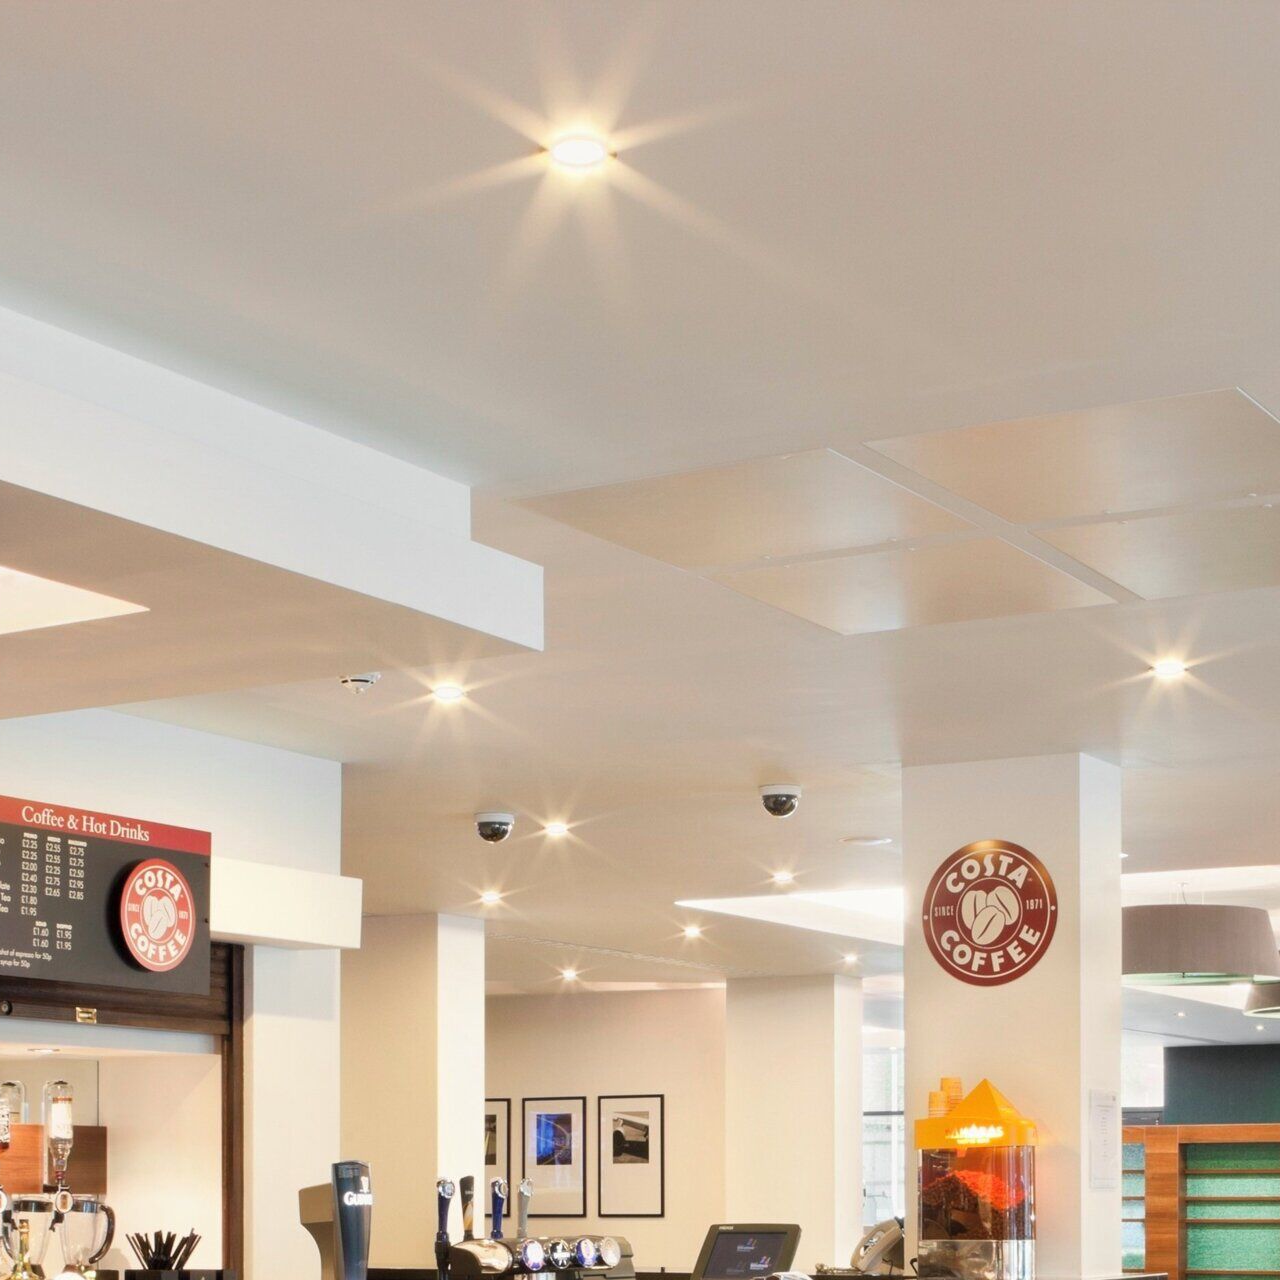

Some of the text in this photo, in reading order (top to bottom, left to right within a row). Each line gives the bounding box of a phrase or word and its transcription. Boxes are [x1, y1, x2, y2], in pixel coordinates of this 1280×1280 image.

[22, 806, 150, 842] Coffee & Hot Drinks
[22, 839, 37, 849] £2.25
[46, 843, 61, 853] £2.55
[70, 846, 84, 856] £2.75
[22, 850, 37, 860] £2.25
[46, 854, 60, 864] £2.55
[70, 858, 84, 867] £2.75
[22, 862, 37, 871] £2.00
[46, 865, 60, 875] £2.25
[69, 869, 84, 878] £2.50
[946, 854, 1029, 894] COSTA
[22, 873, 37, 882] £2.40
[46, 876, 60, 886] £2.75
[69, 880, 84, 889] £2.95
[135, 870, 182, 902] COSTA
[1, 892, 11, 902] Tea
[21, 895, 37, 905] £1.80
[22, 884, 37, 893] £2.30
[45, 887, 60, 897] £2.65
[69, 891, 84, 900] £2.85
[21, 906, 36, 916] £1.95
[934, 899, 1043, 917] SINCE 1971
[33, 927, 49, 937] £1.60
[56, 930, 72, 939] £1.95
[33, 938, 49, 948] £1.60
[56, 941, 72, 950] £1.95
[131, 923, 186, 962] COFFEE
[941, 925, 1041, 972] COFFEE
[16, 951, 34, 960] espresso
[42, 952, 52, 961] 50p
[20, 960, 30, 968] 50p
